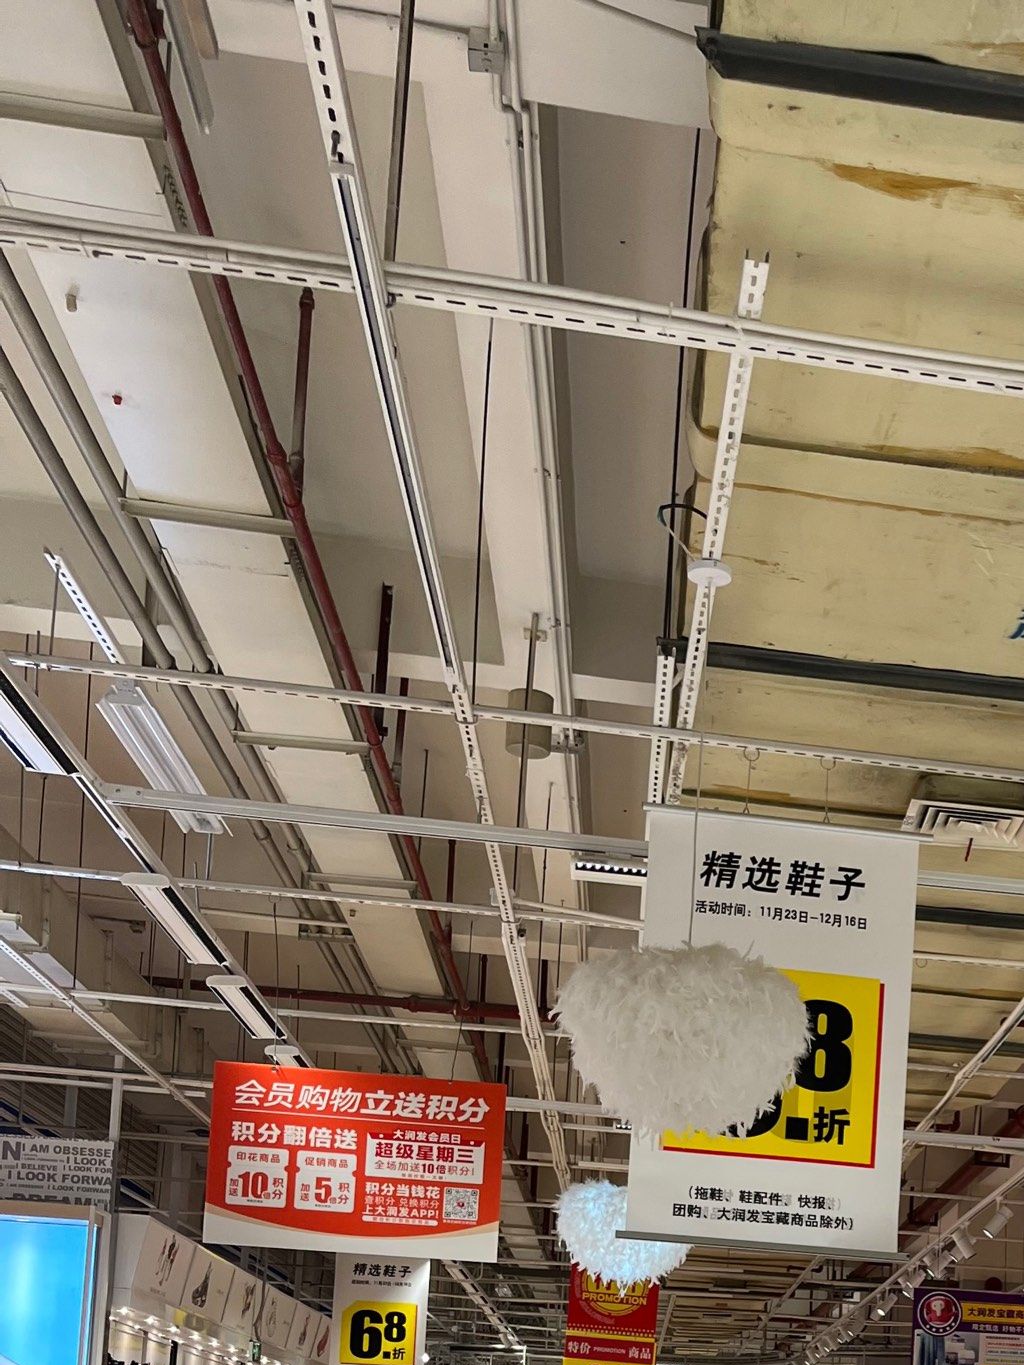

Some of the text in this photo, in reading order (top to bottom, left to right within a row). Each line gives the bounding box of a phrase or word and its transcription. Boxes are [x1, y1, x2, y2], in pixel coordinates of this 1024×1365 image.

[700, 850, 866, 902] 精选鞋子
[235, 1079, 490, 1124] 会员购物立送积分
[231, 1121, 357, 1150] 积分翻倍送
[393, 1129, 461, 1145] 大润发会员日
[30, 1143, 49, 1154] AM
[374, 1142, 474, 1164] 超级星期三
[73, 1156, 107, 1167] LOOK
[236, 1151, 280, 1163] 印花商品
[305, 1157, 348, 1168] 促销商品
[21, 1163, 58, 1172] BELIEVE
[68, 1165, 92, 1173] LOOK
[16, 1170, 57, 1183] LOOK
[52, 1184, 74, 1192] LOOK
[365, 1182, 440, 1199] 积分当钱花
[353, 1262, 412, 1278] 精选鞋子
